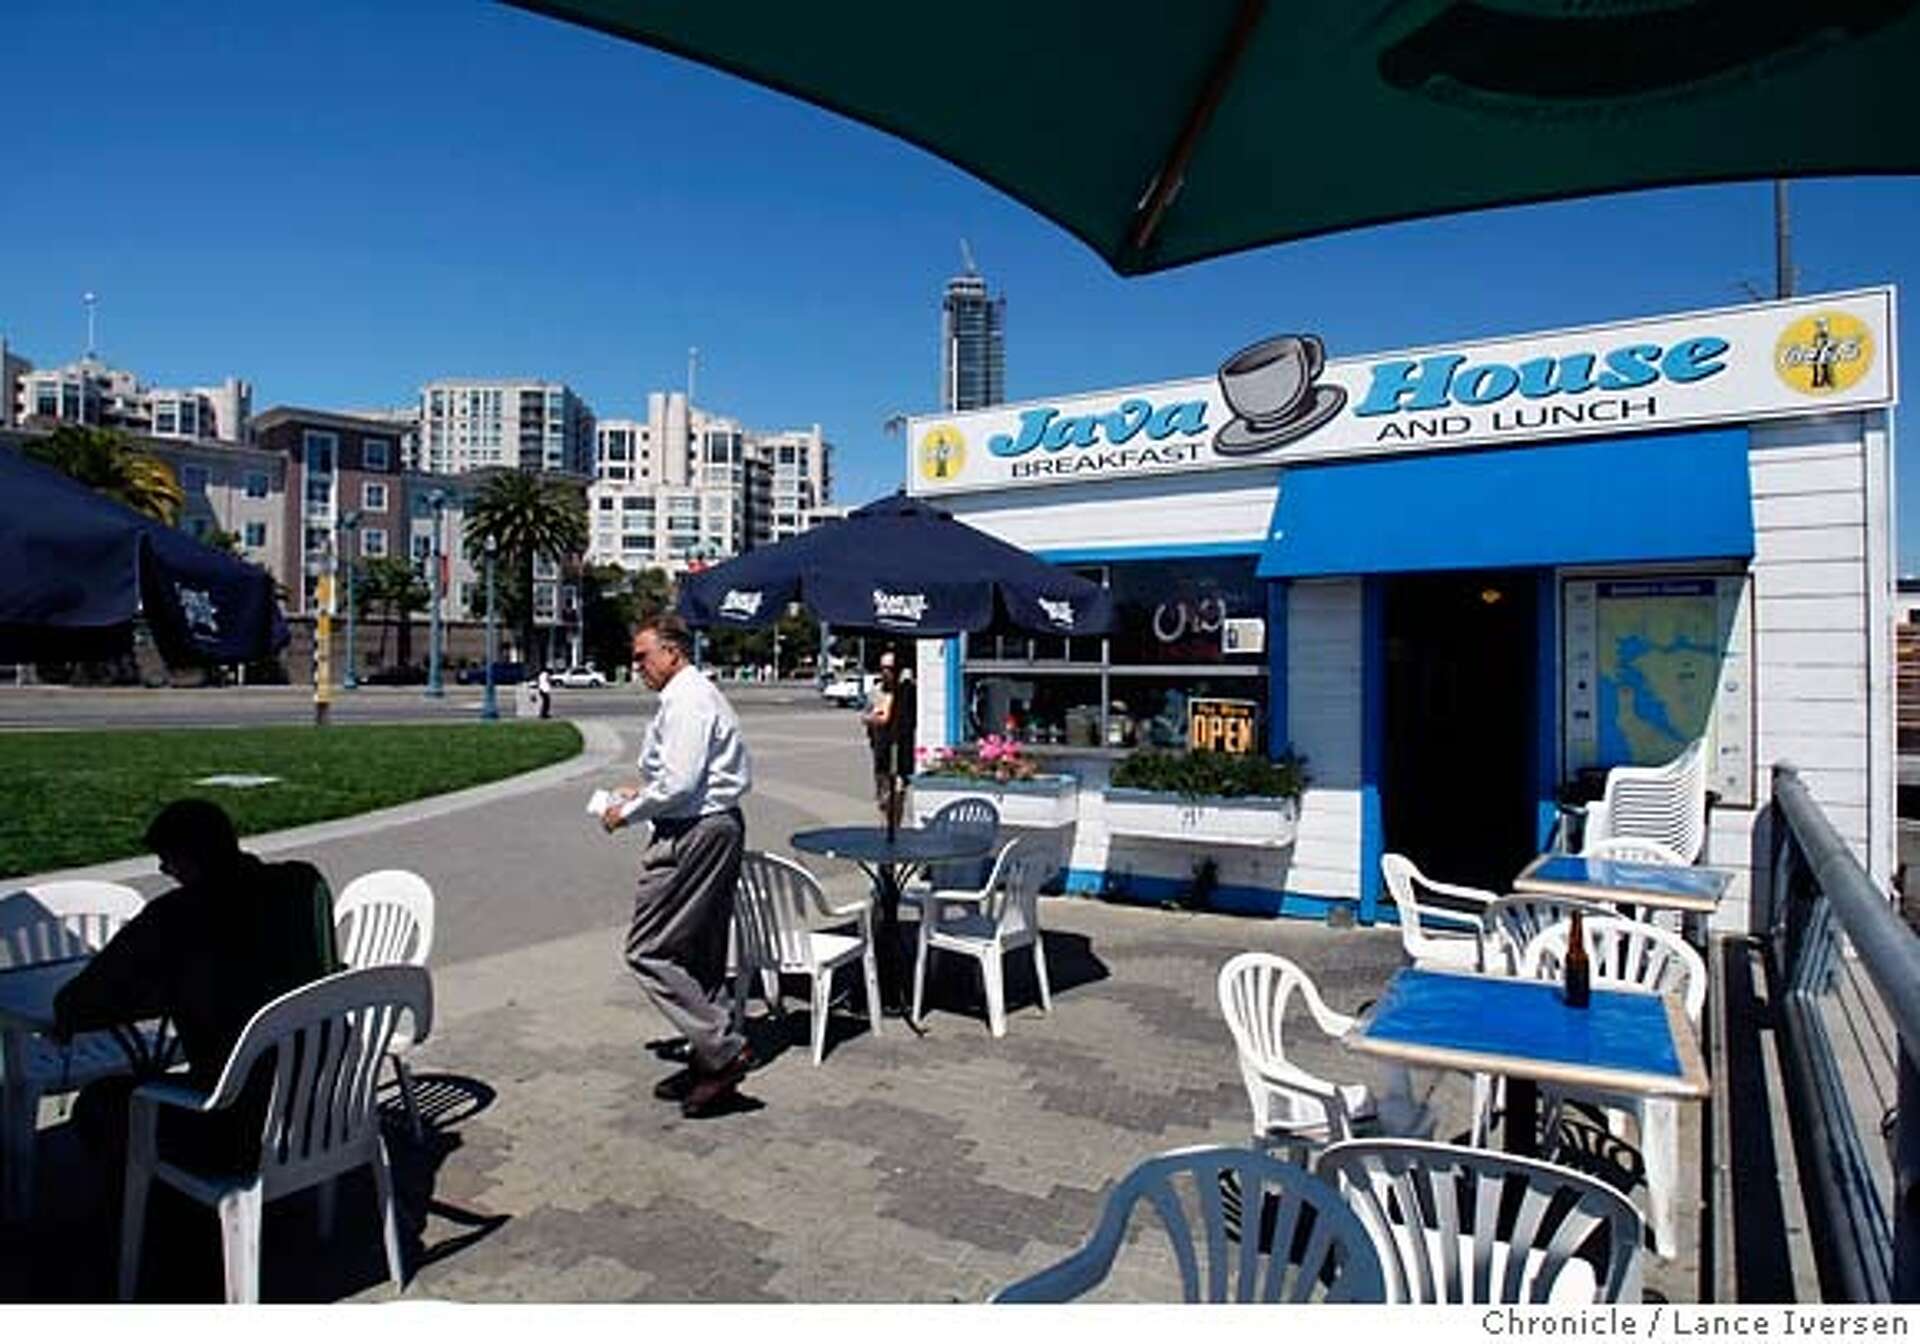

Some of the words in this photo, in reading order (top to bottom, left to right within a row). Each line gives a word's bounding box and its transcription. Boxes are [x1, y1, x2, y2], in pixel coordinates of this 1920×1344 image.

[988, 398, 1209, 458] Java
[1353, 336, 1730, 418] House
[1011, 442, 1205, 479] BREAKFAST
[1376, 415, 1472, 441] AND
[1492, 397, 1658, 430] LUNCH
[1194, 714, 1253, 752] OPEN
